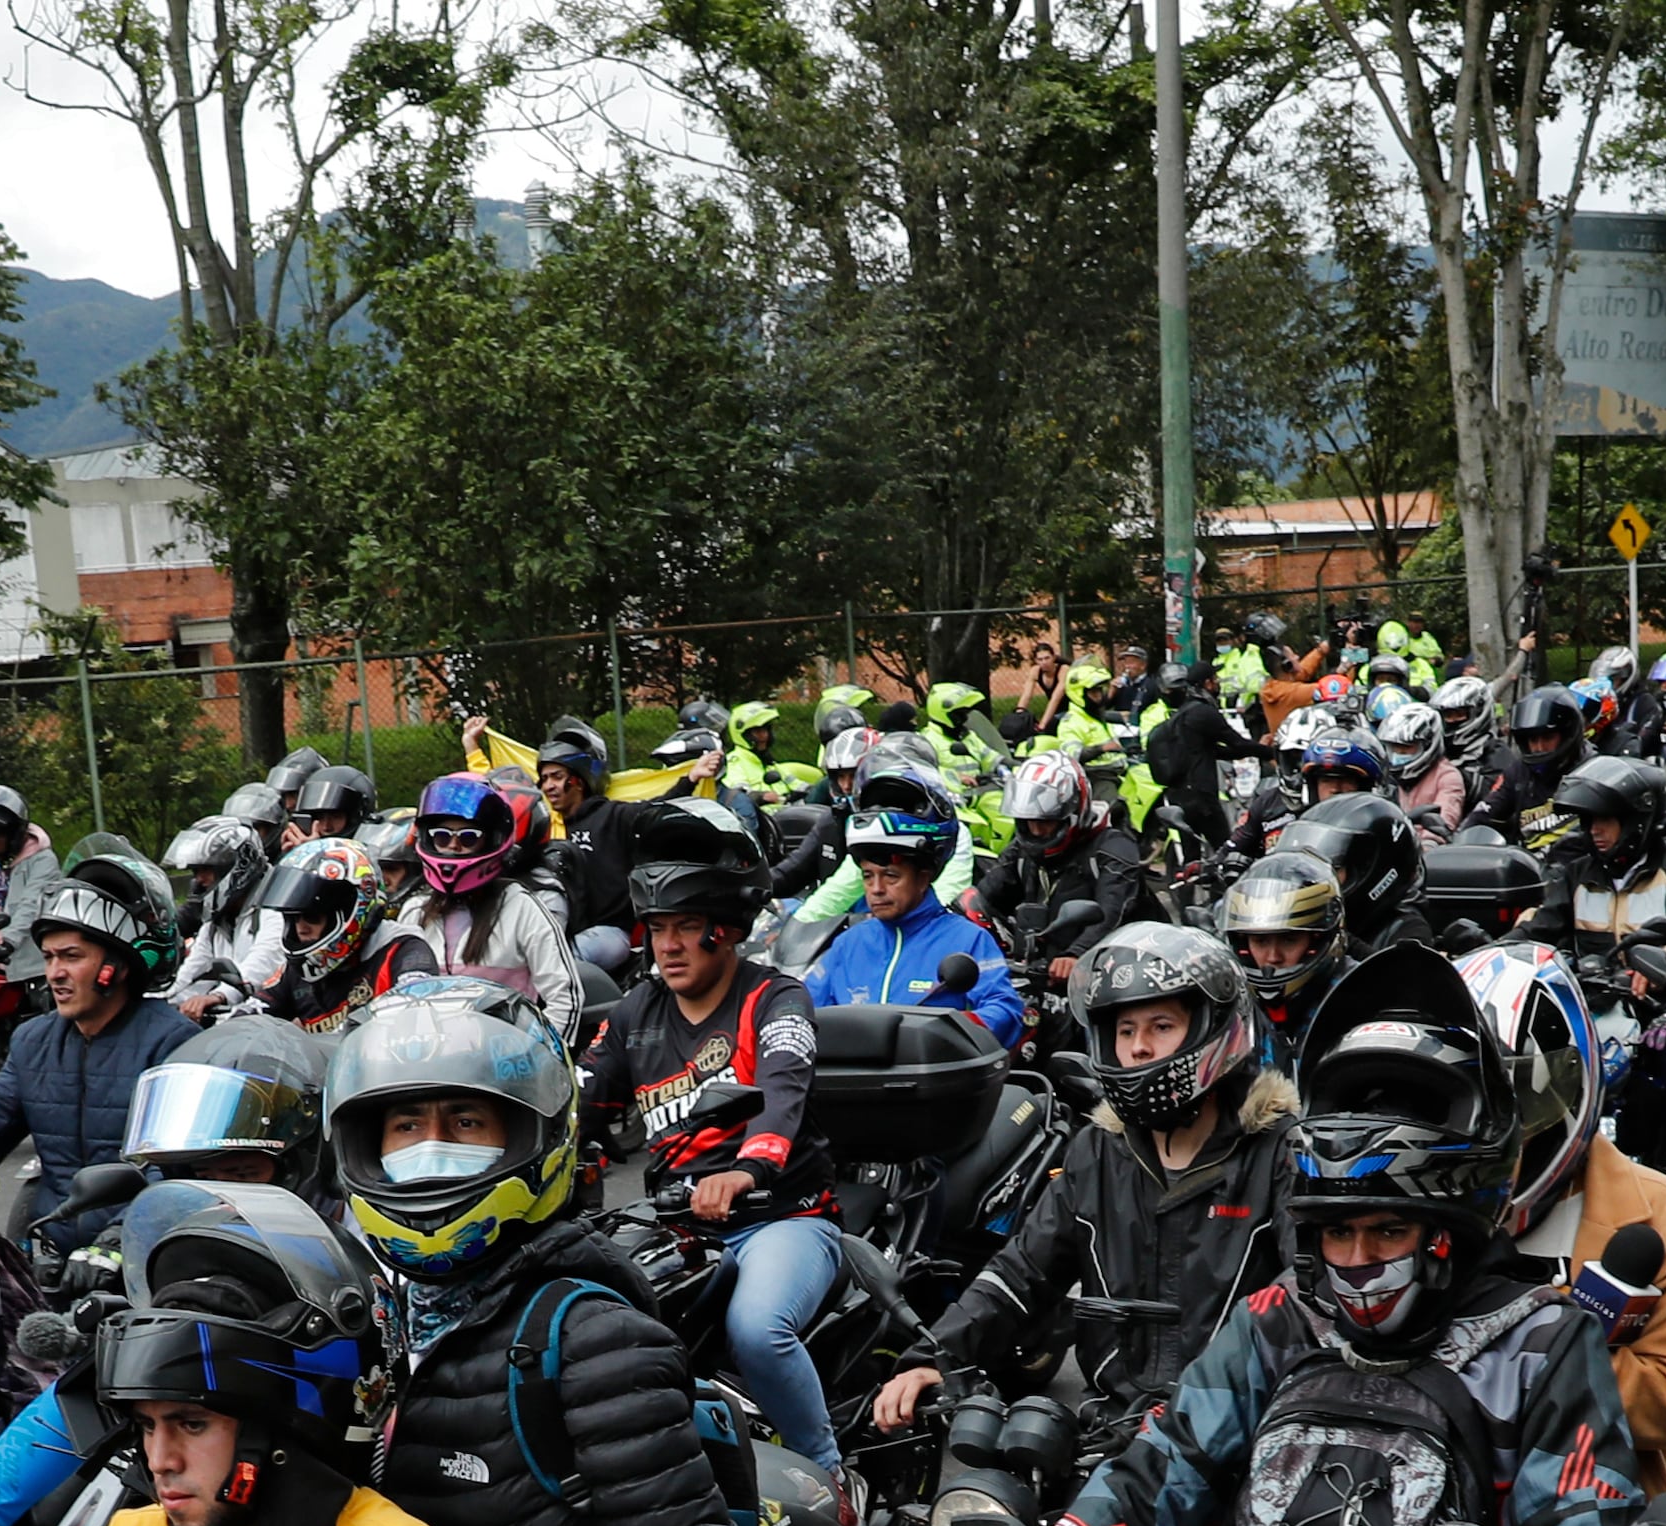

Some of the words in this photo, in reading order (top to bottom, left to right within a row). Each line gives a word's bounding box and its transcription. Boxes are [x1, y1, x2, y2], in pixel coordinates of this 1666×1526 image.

[1561, 329, 1610, 360] Alto
[1573, 1287, 1616, 1319] noticias
[454, 1451, 472, 1463] THE
